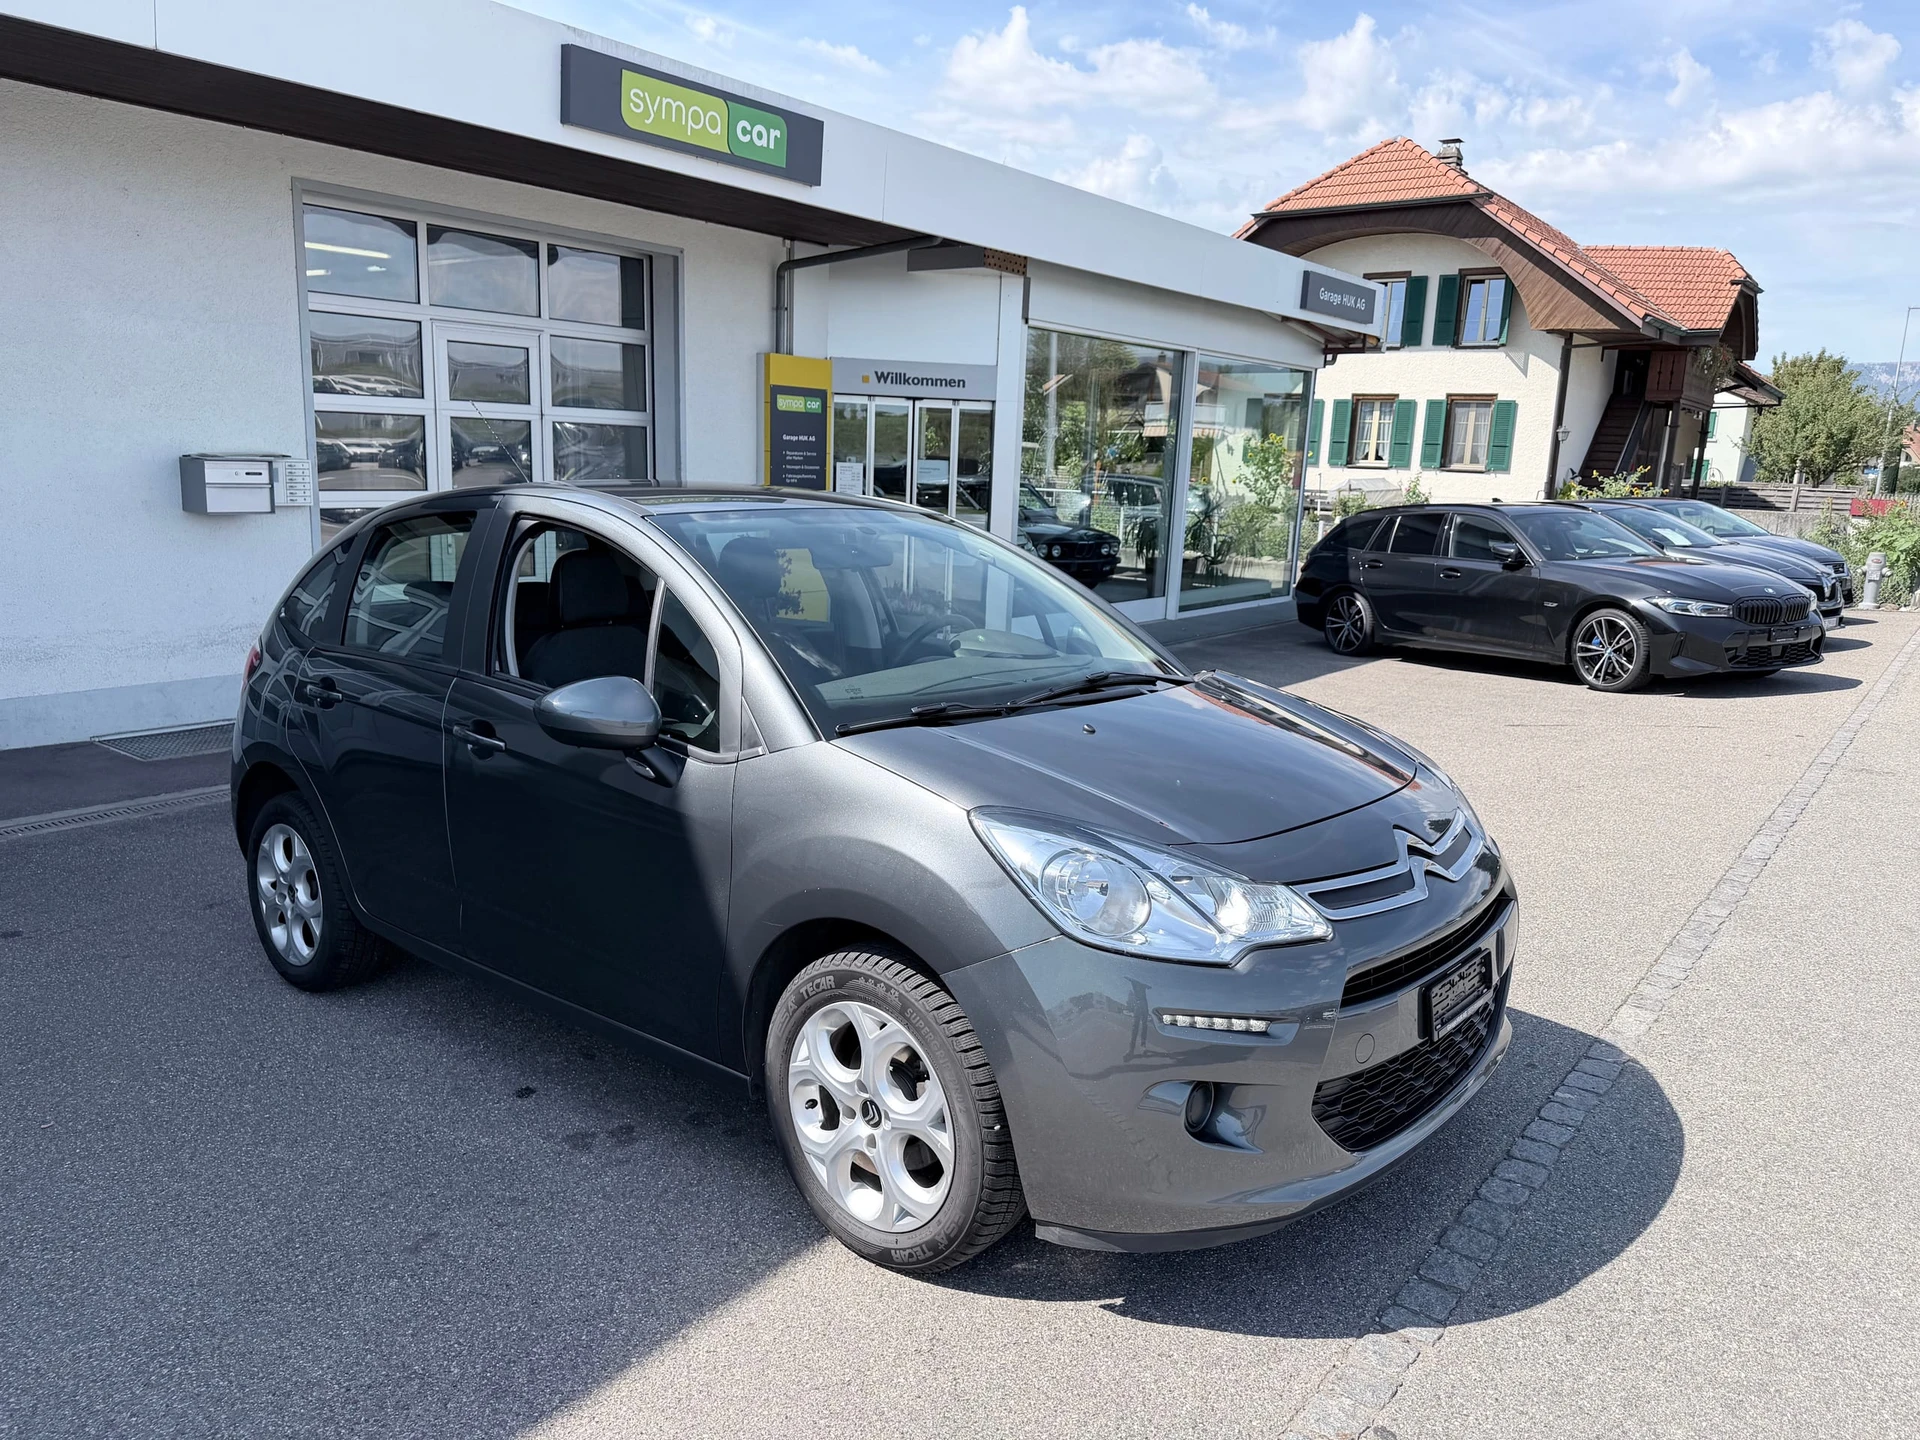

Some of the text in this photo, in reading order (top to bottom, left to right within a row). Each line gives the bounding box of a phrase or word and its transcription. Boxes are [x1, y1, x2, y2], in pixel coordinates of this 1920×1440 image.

[629, 88, 781, 149] sympa car
[1319, 287, 1366, 311] Garage HUK AG
[874, 371, 966, 388] Willkommen
[779, 398, 803, 409] sympa
[799, 975, 836, 1000] TECAR
[904, 1007, 952, 1071] SUPERGRIP
